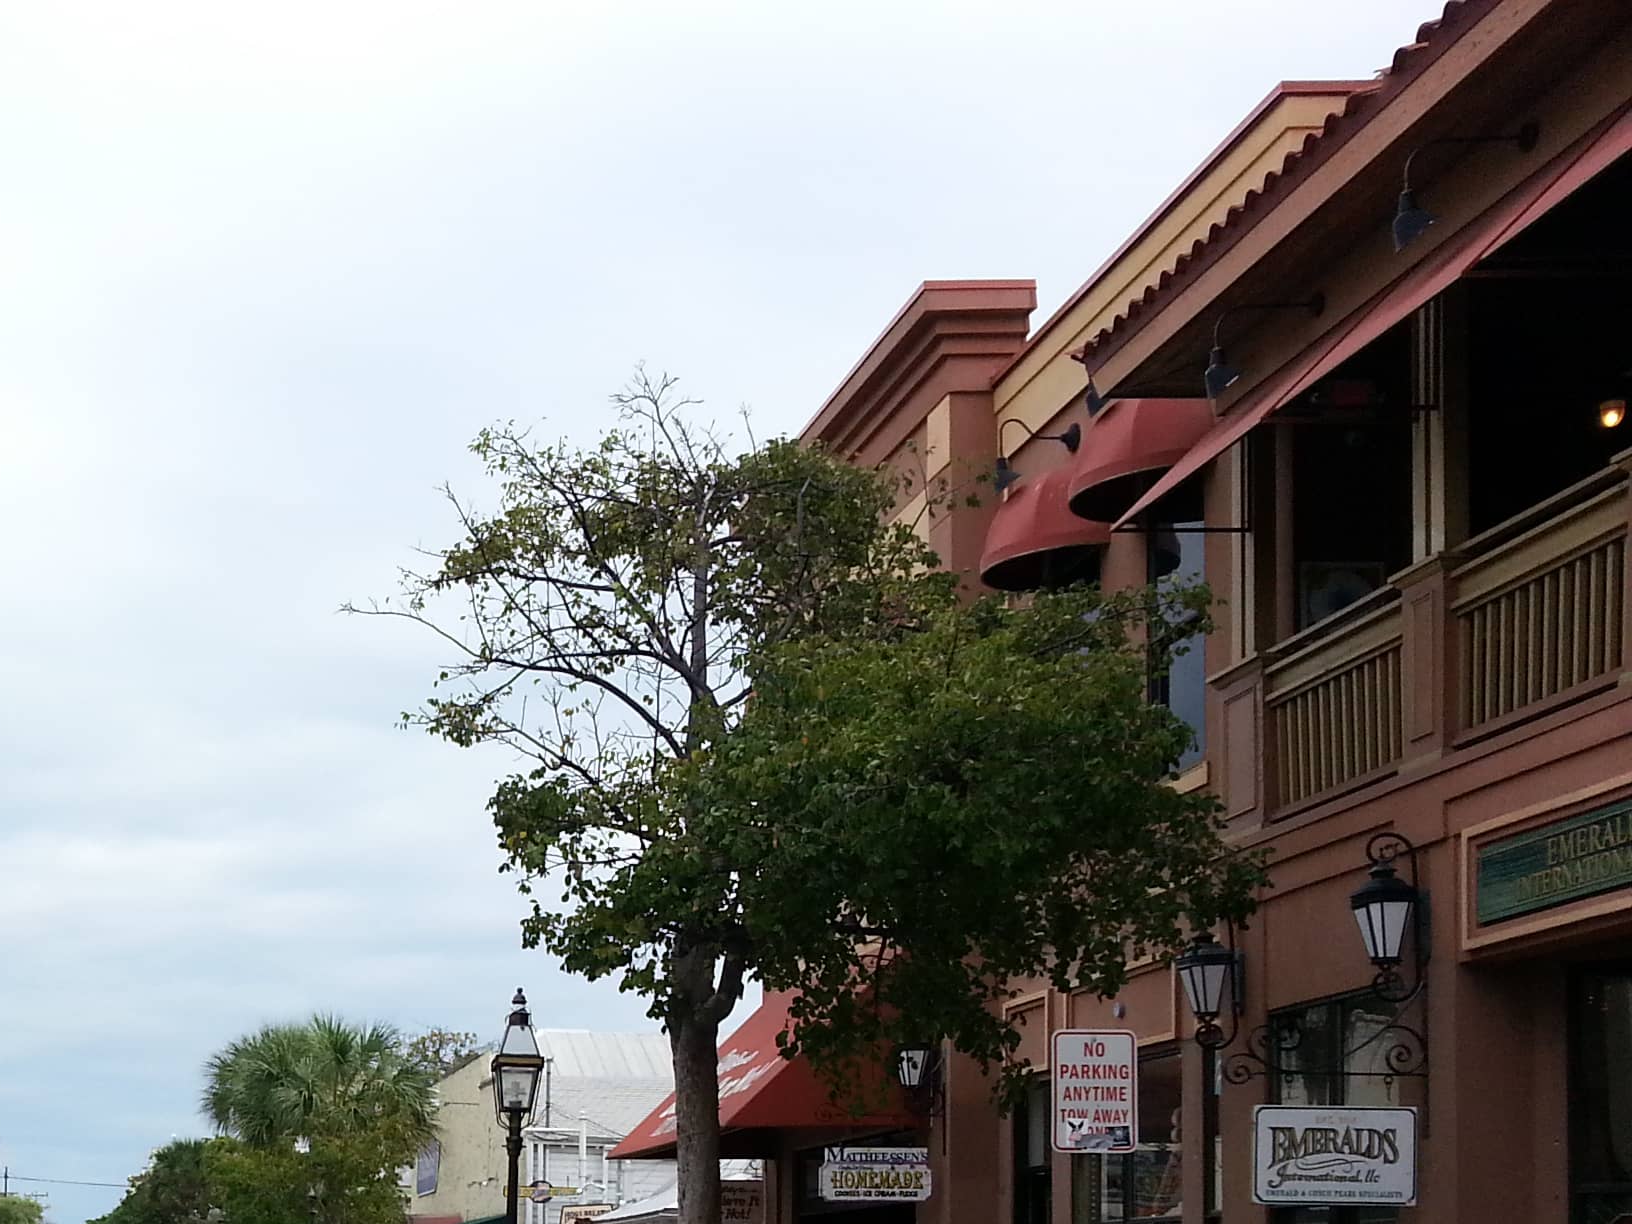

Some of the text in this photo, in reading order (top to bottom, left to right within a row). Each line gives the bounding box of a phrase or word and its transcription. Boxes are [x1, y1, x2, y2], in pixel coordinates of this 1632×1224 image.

[1547, 813, 1632, 866] EMERAL
[1083, 1042, 1105, 1057] NO
[1060, 1064, 1130, 1079] PARKING
[1063, 1086, 1127, 1101] ANYTIME
[1093, 1109, 1129, 1122] AWAY
[827, 1146, 928, 1162] MATTHEESSEN'S
[1267, 1125, 1400, 1169] EMERALDS
[831, 1170, 924, 1189] HOMEMADE
